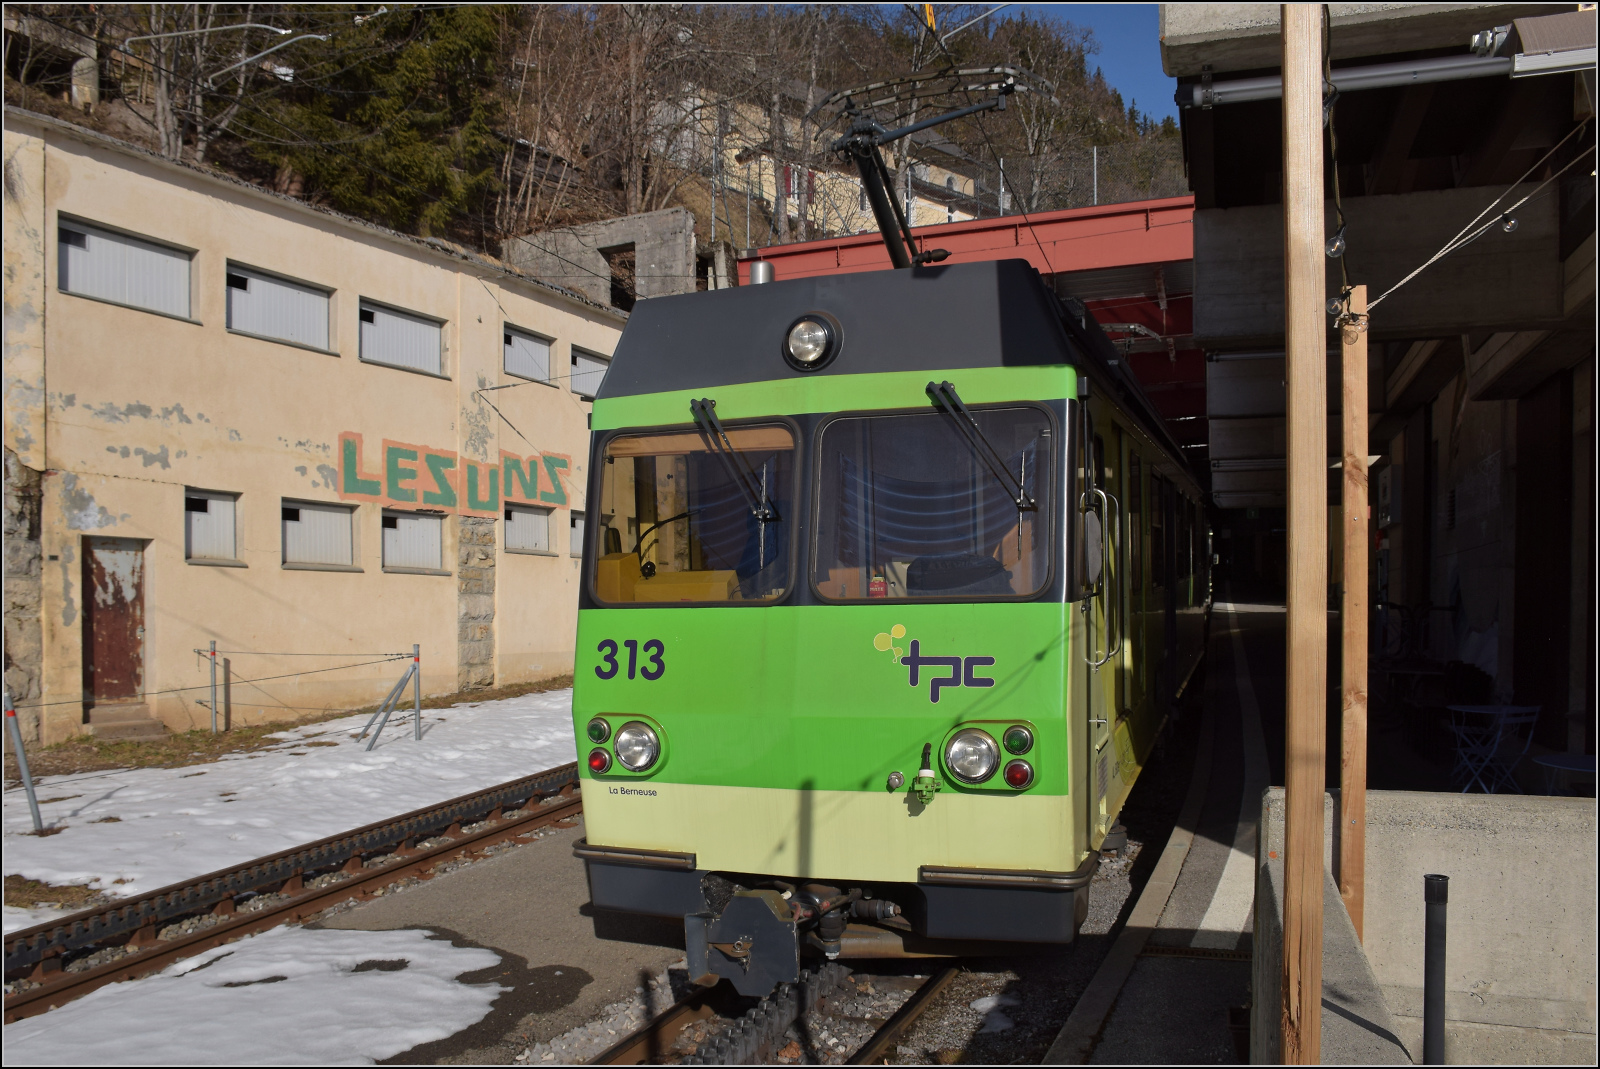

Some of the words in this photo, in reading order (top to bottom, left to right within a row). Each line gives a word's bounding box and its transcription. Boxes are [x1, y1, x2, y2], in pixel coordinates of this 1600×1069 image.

[594, 638, 666, 681] 313
[900, 638, 996, 704] tpc
[608, 786, 618, 794] La
[620, 786, 657, 796] Berneuse
